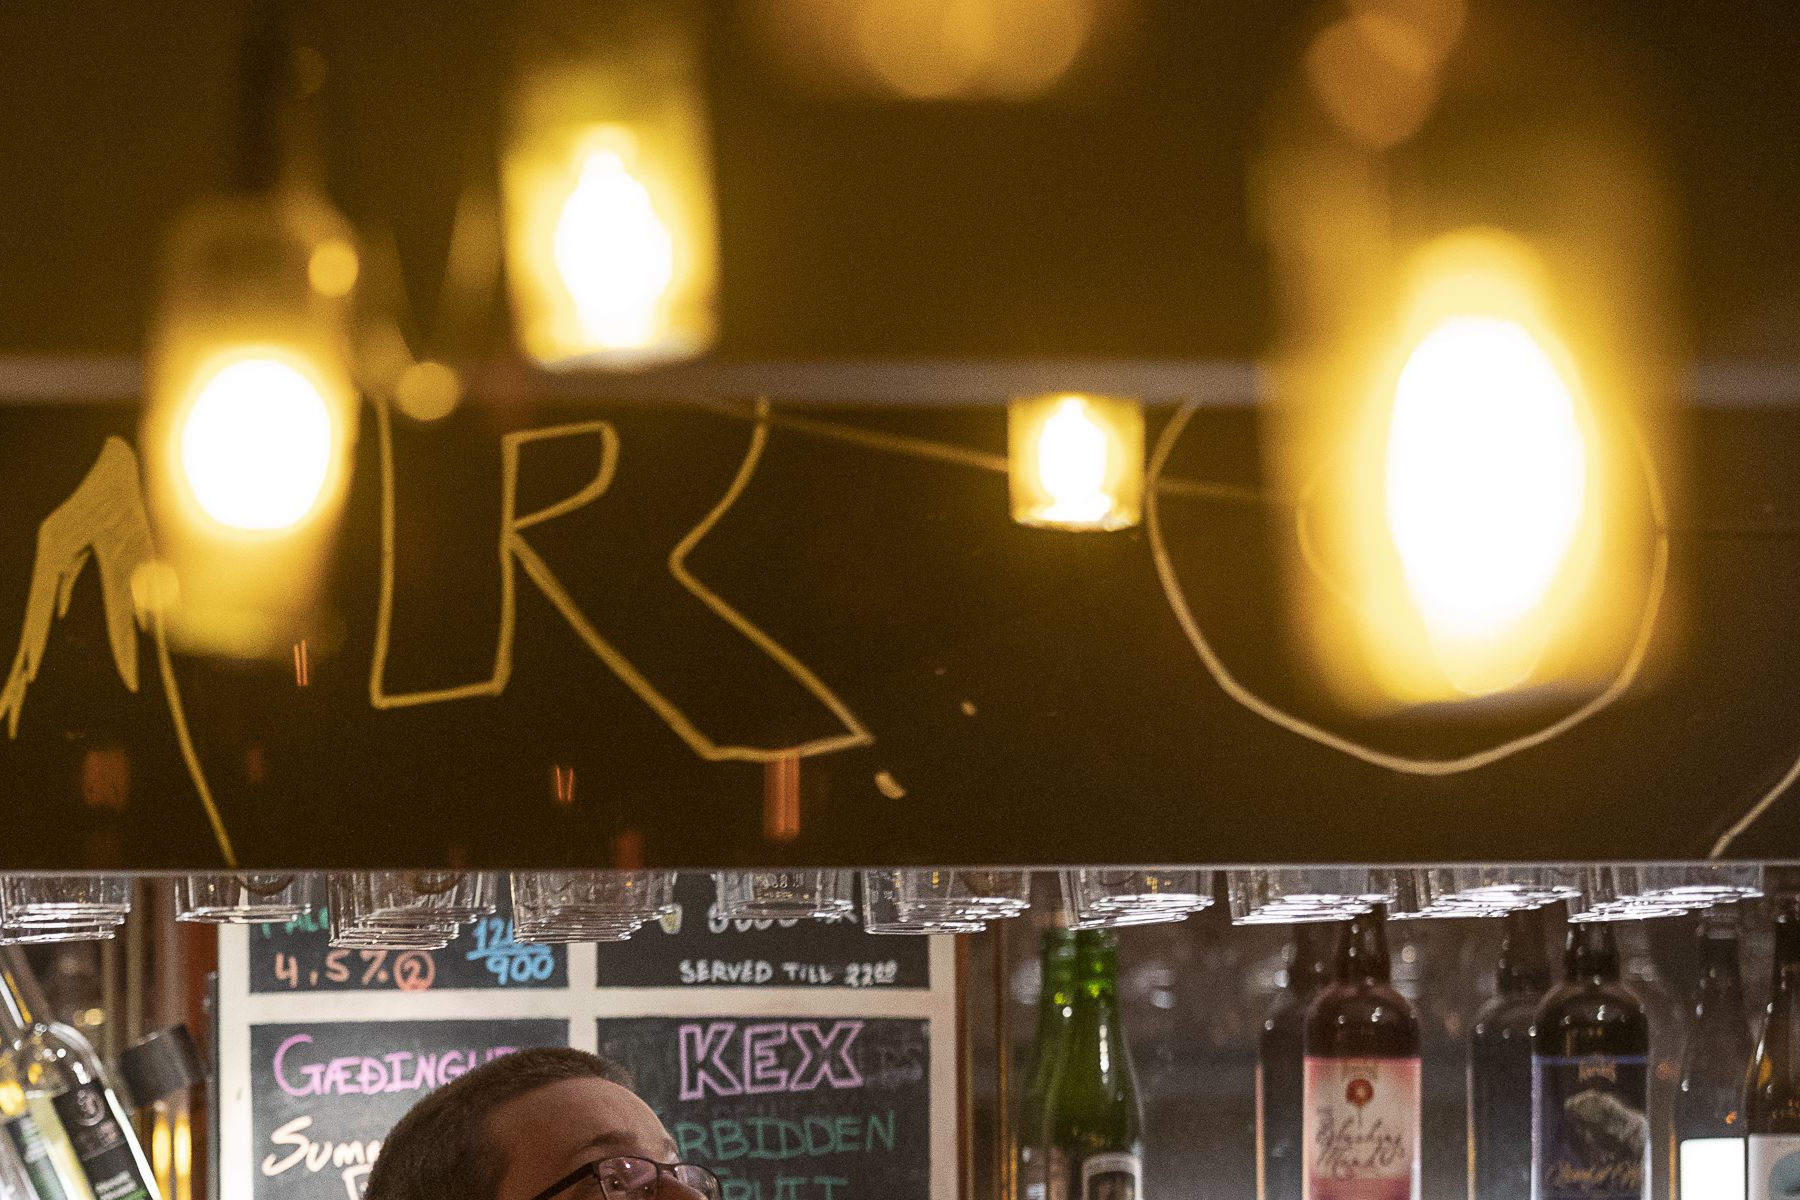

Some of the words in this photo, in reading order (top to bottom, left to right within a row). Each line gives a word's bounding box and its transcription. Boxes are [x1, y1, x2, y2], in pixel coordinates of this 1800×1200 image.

[486, 953, 554, 985] 900
[678, 958, 774, 985] SERVED
[679, 1020, 865, 1101] KEX
[672, 1110, 897, 1161] RBIDDEN
